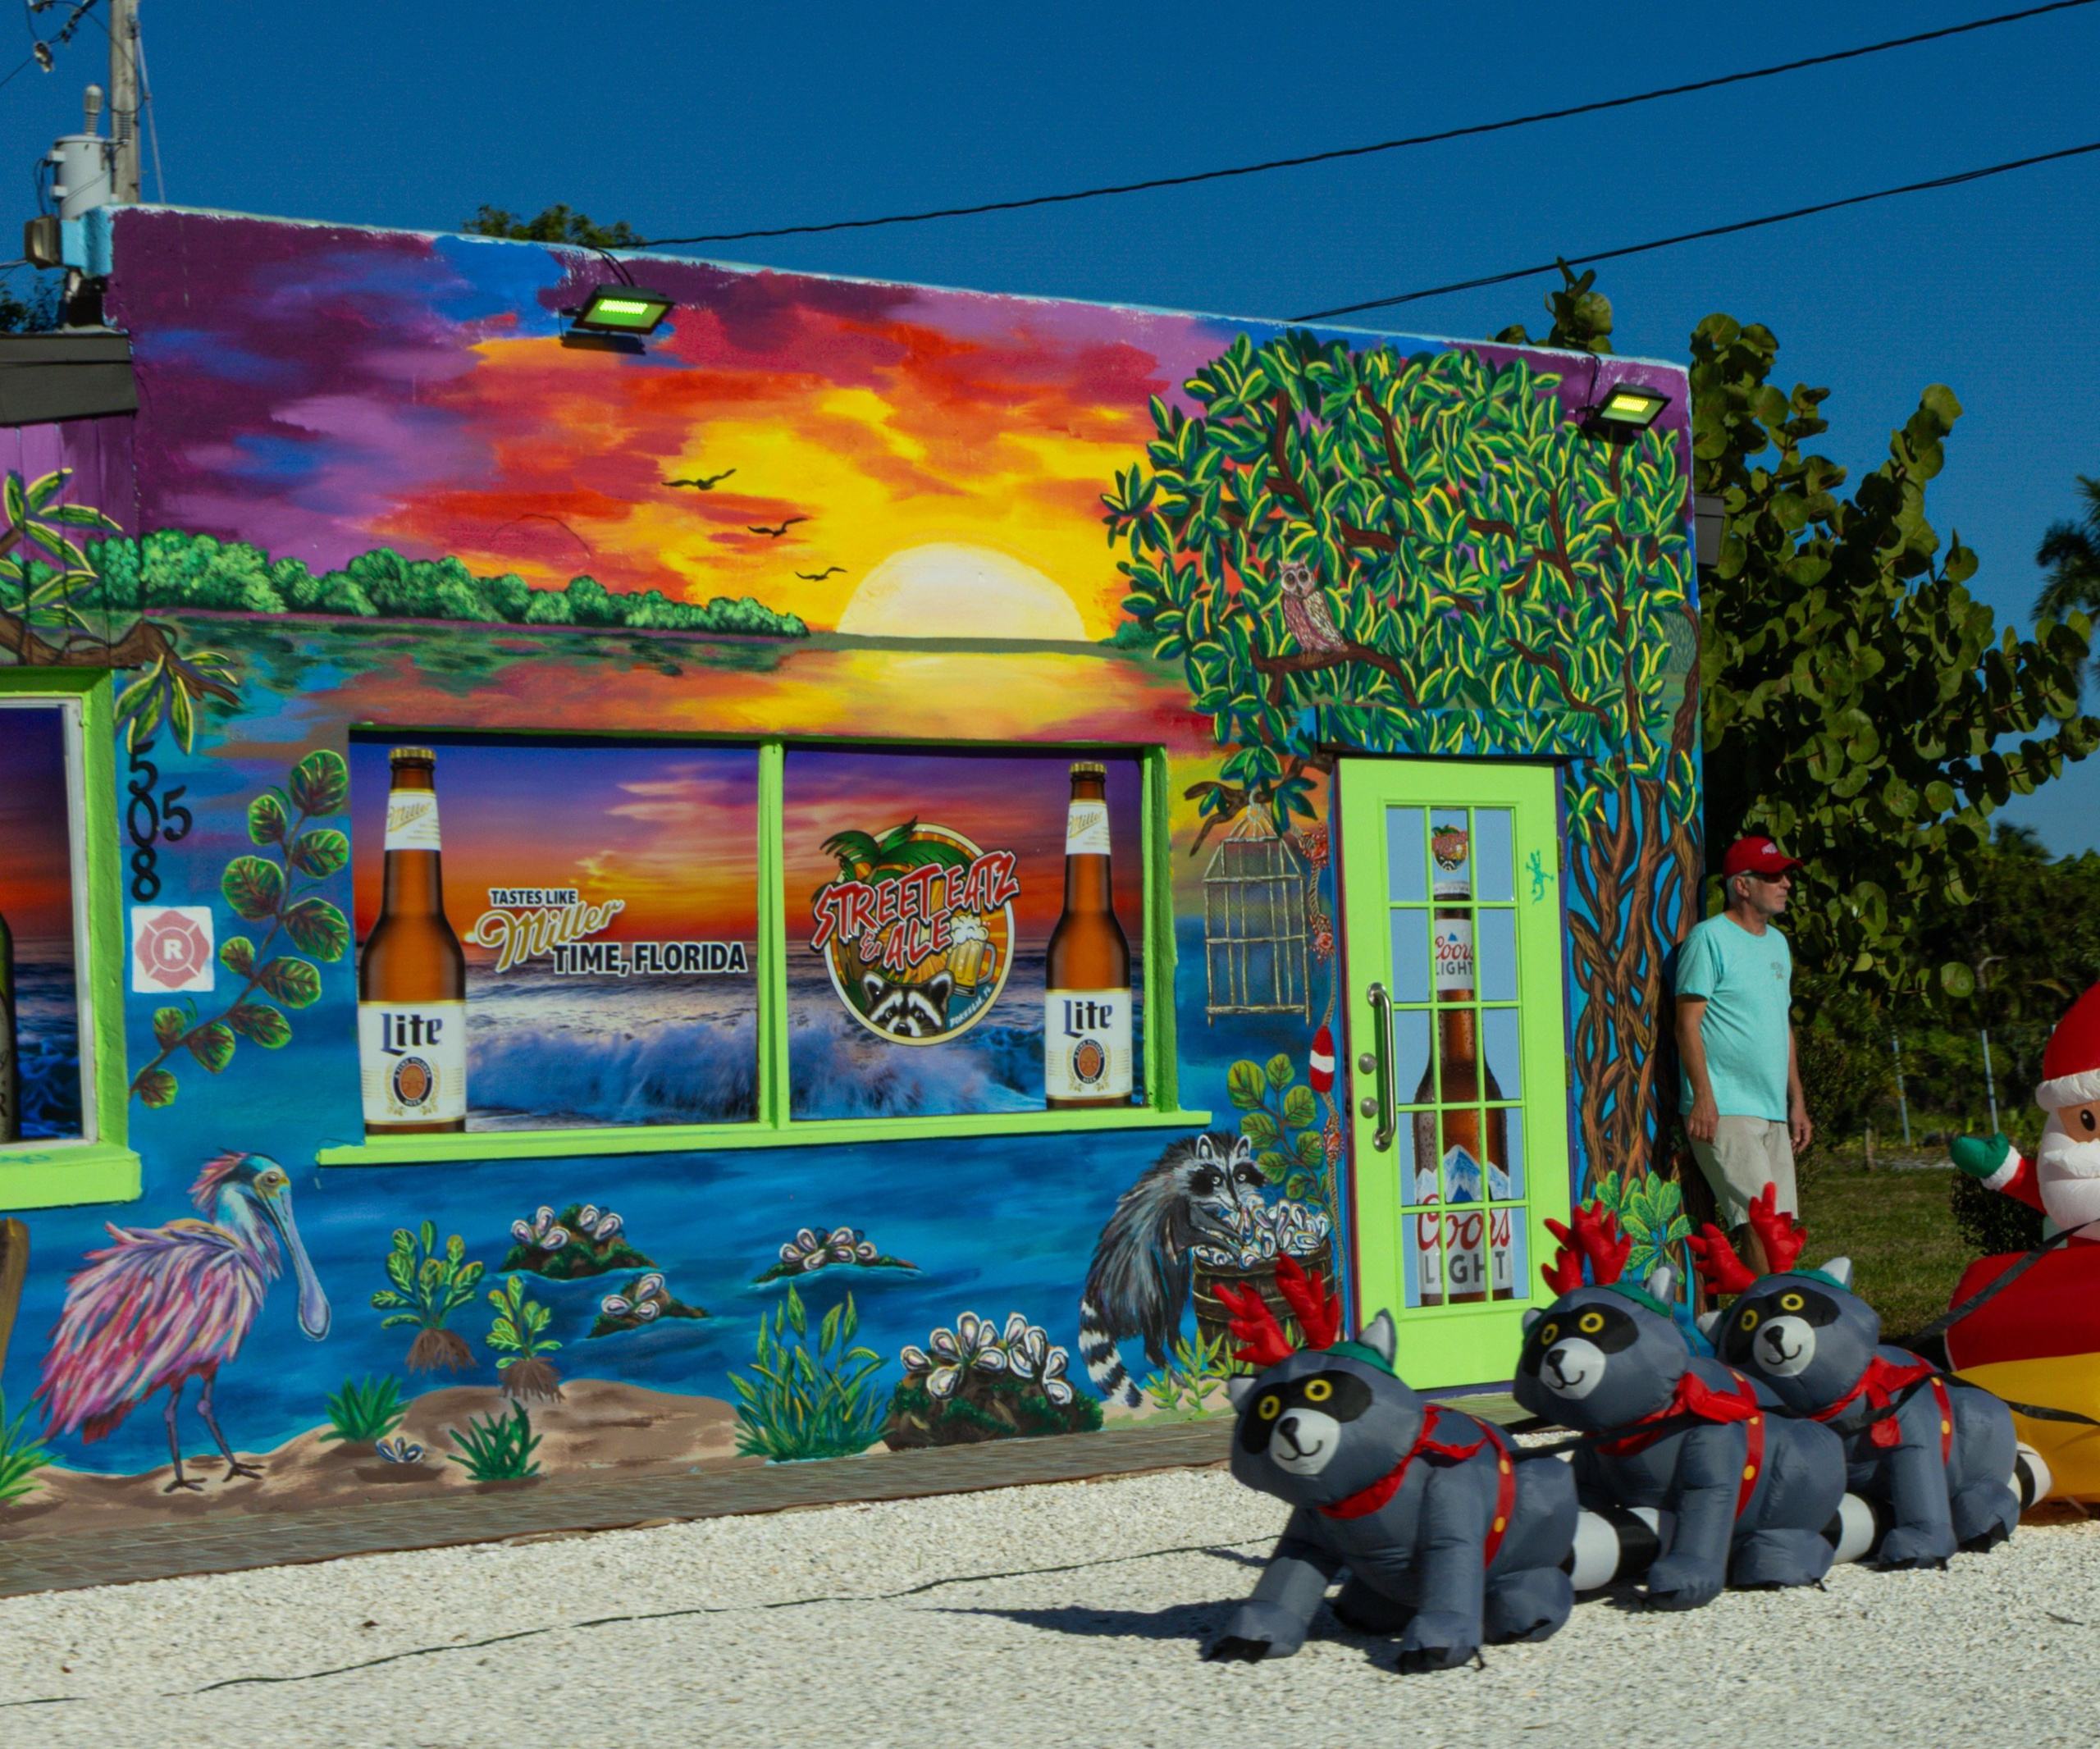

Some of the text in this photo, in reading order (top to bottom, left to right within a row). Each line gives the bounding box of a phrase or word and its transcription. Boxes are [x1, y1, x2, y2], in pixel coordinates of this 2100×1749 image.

[490, 889, 578, 906] TASTES LIKE
[810, 850, 1020, 951] STREET EATZ
[164, 939, 183, 960] R
[475, 900, 625, 973] Miller
[883, 910, 952, 971] ALE
[552, 943, 748, 975] TIME, FLORIDA
[380, 1013, 443, 1057] Lite
[1062, 999, 1113, 1039] Lite
[1424, 1251, 1505, 1285] LGHT
